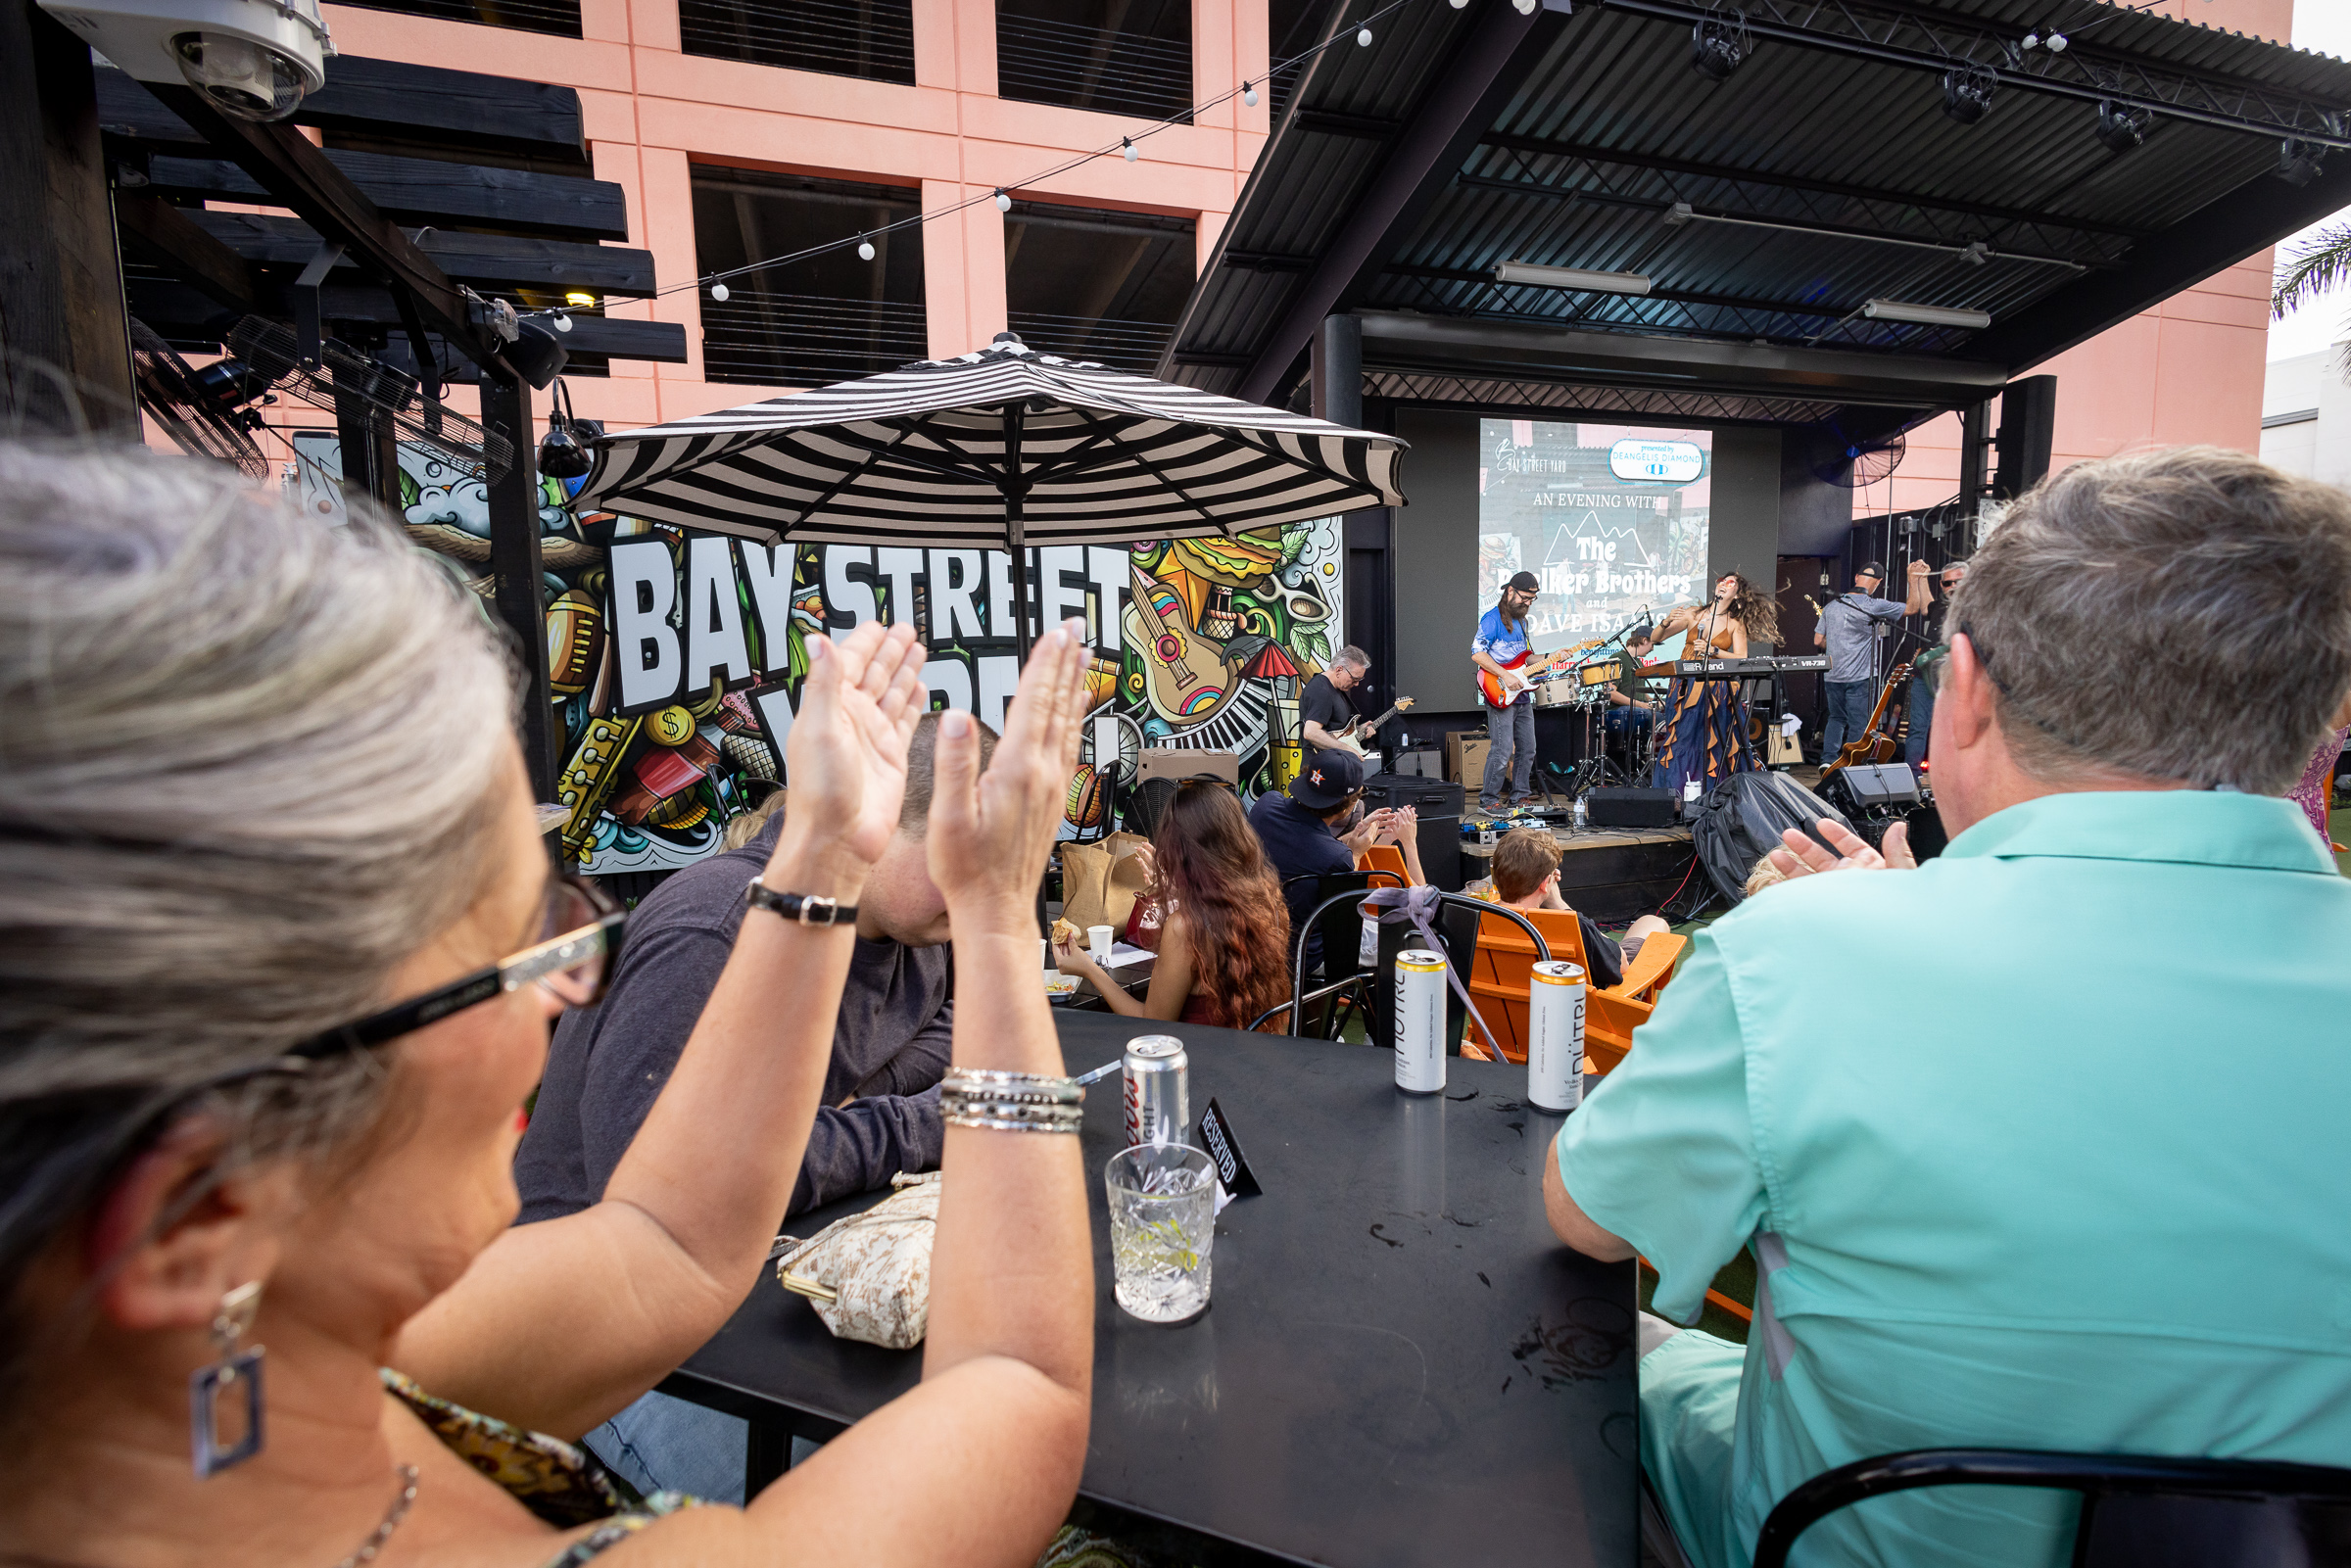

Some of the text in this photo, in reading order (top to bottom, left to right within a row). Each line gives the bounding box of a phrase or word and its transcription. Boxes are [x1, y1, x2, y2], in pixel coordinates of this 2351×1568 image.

[1509, 458, 1566, 473] BAY STREET YARD
[1612, 451, 1701, 463] DEANGELIS DIAMOND
[1533, 493, 1662, 509] AN EVENING WITH
[1576, 536, 1616, 562] The
[1497, 567, 1692, 595] lker Brothers
[1586, 596, 1608, 608] and
[610, 537, 1131, 708] BAY STREET
[1525, 613, 1582, 633] DAVE
[1694, 661, 1725, 671] Rand
[1142, 1105, 1155, 1144] IGHT
[1201, 1107, 1237, 1184] RESERVED
